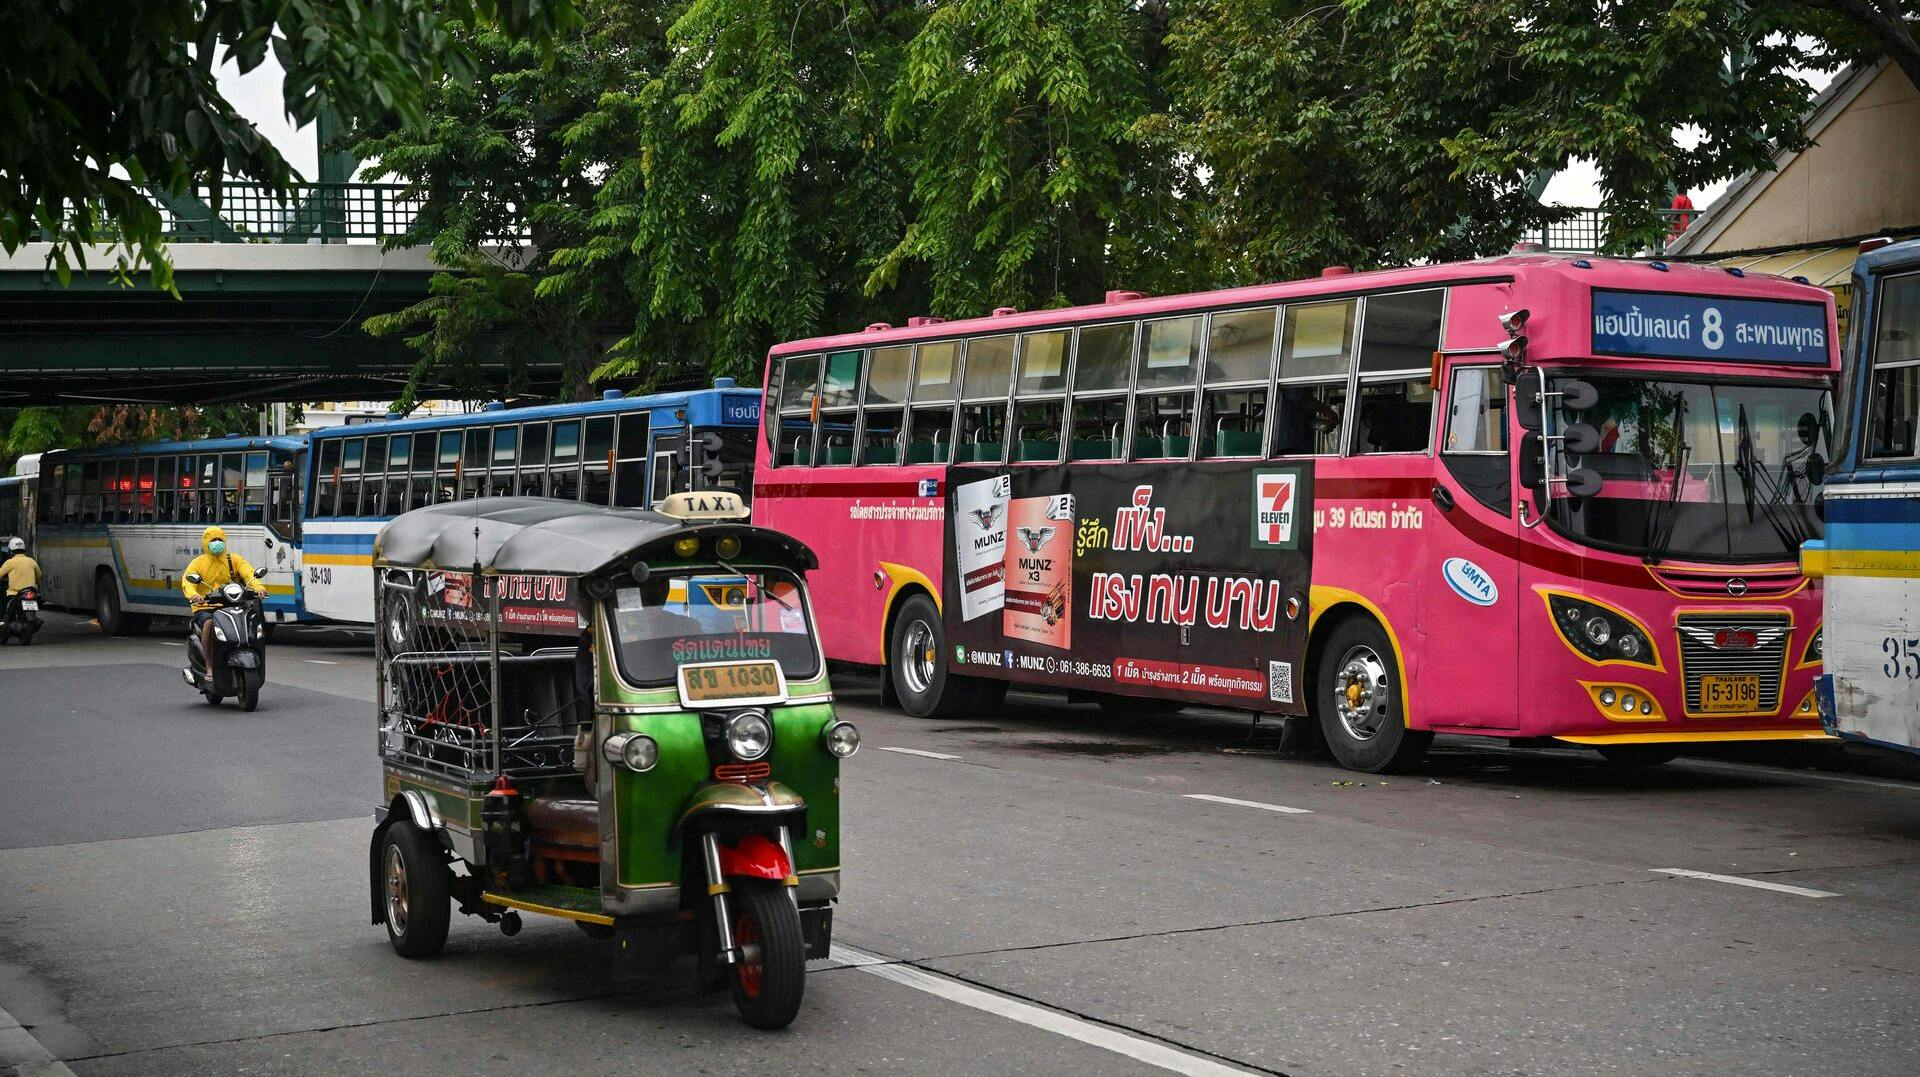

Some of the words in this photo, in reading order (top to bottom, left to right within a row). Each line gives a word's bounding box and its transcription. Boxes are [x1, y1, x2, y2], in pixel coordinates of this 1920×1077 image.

[1595, 305, 1690, 340] แฮปปี้แลนด์
[1702, 307, 1725, 350] 8
[1736, 322, 1824, 352] สะพานพุทธ
[1002, 476, 1009, 488] 2
[684, 496, 735, 512] TAXI
[1060, 497, 1068, 510] 2
[1262, 482, 1290, 544] 7
[1329, 507, 1346, 528] 39
[1349, 506, 1387, 529] เดินรถ
[1391, 501, 1423, 529] จำกัด
[974, 532, 1005, 551] MUNZ
[1076, 518, 1109, 557] รู้สึก
[1018, 558, 1052, 571] MUNZ
[310, 567, 332, 585] 39-130
[1461, 562, 1491, 597] BMTA
[1089, 572, 1143, 622] แรง
[1146, 573, 1200, 627] ทน
[1205, 576, 1280, 632] นาน
[726, 666, 775, 688] 1030
[1116, 665, 1122, 676] 1
[1125, 662, 1139, 679] เม็ด
[1182, 670, 1188, 684] 2
[1191, 667, 1206, 686] เม็ด
[1208, 674, 1263, 692] พร้อมทุกกิจกรรม
[1706, 683, 1756, 702] 15-3196
